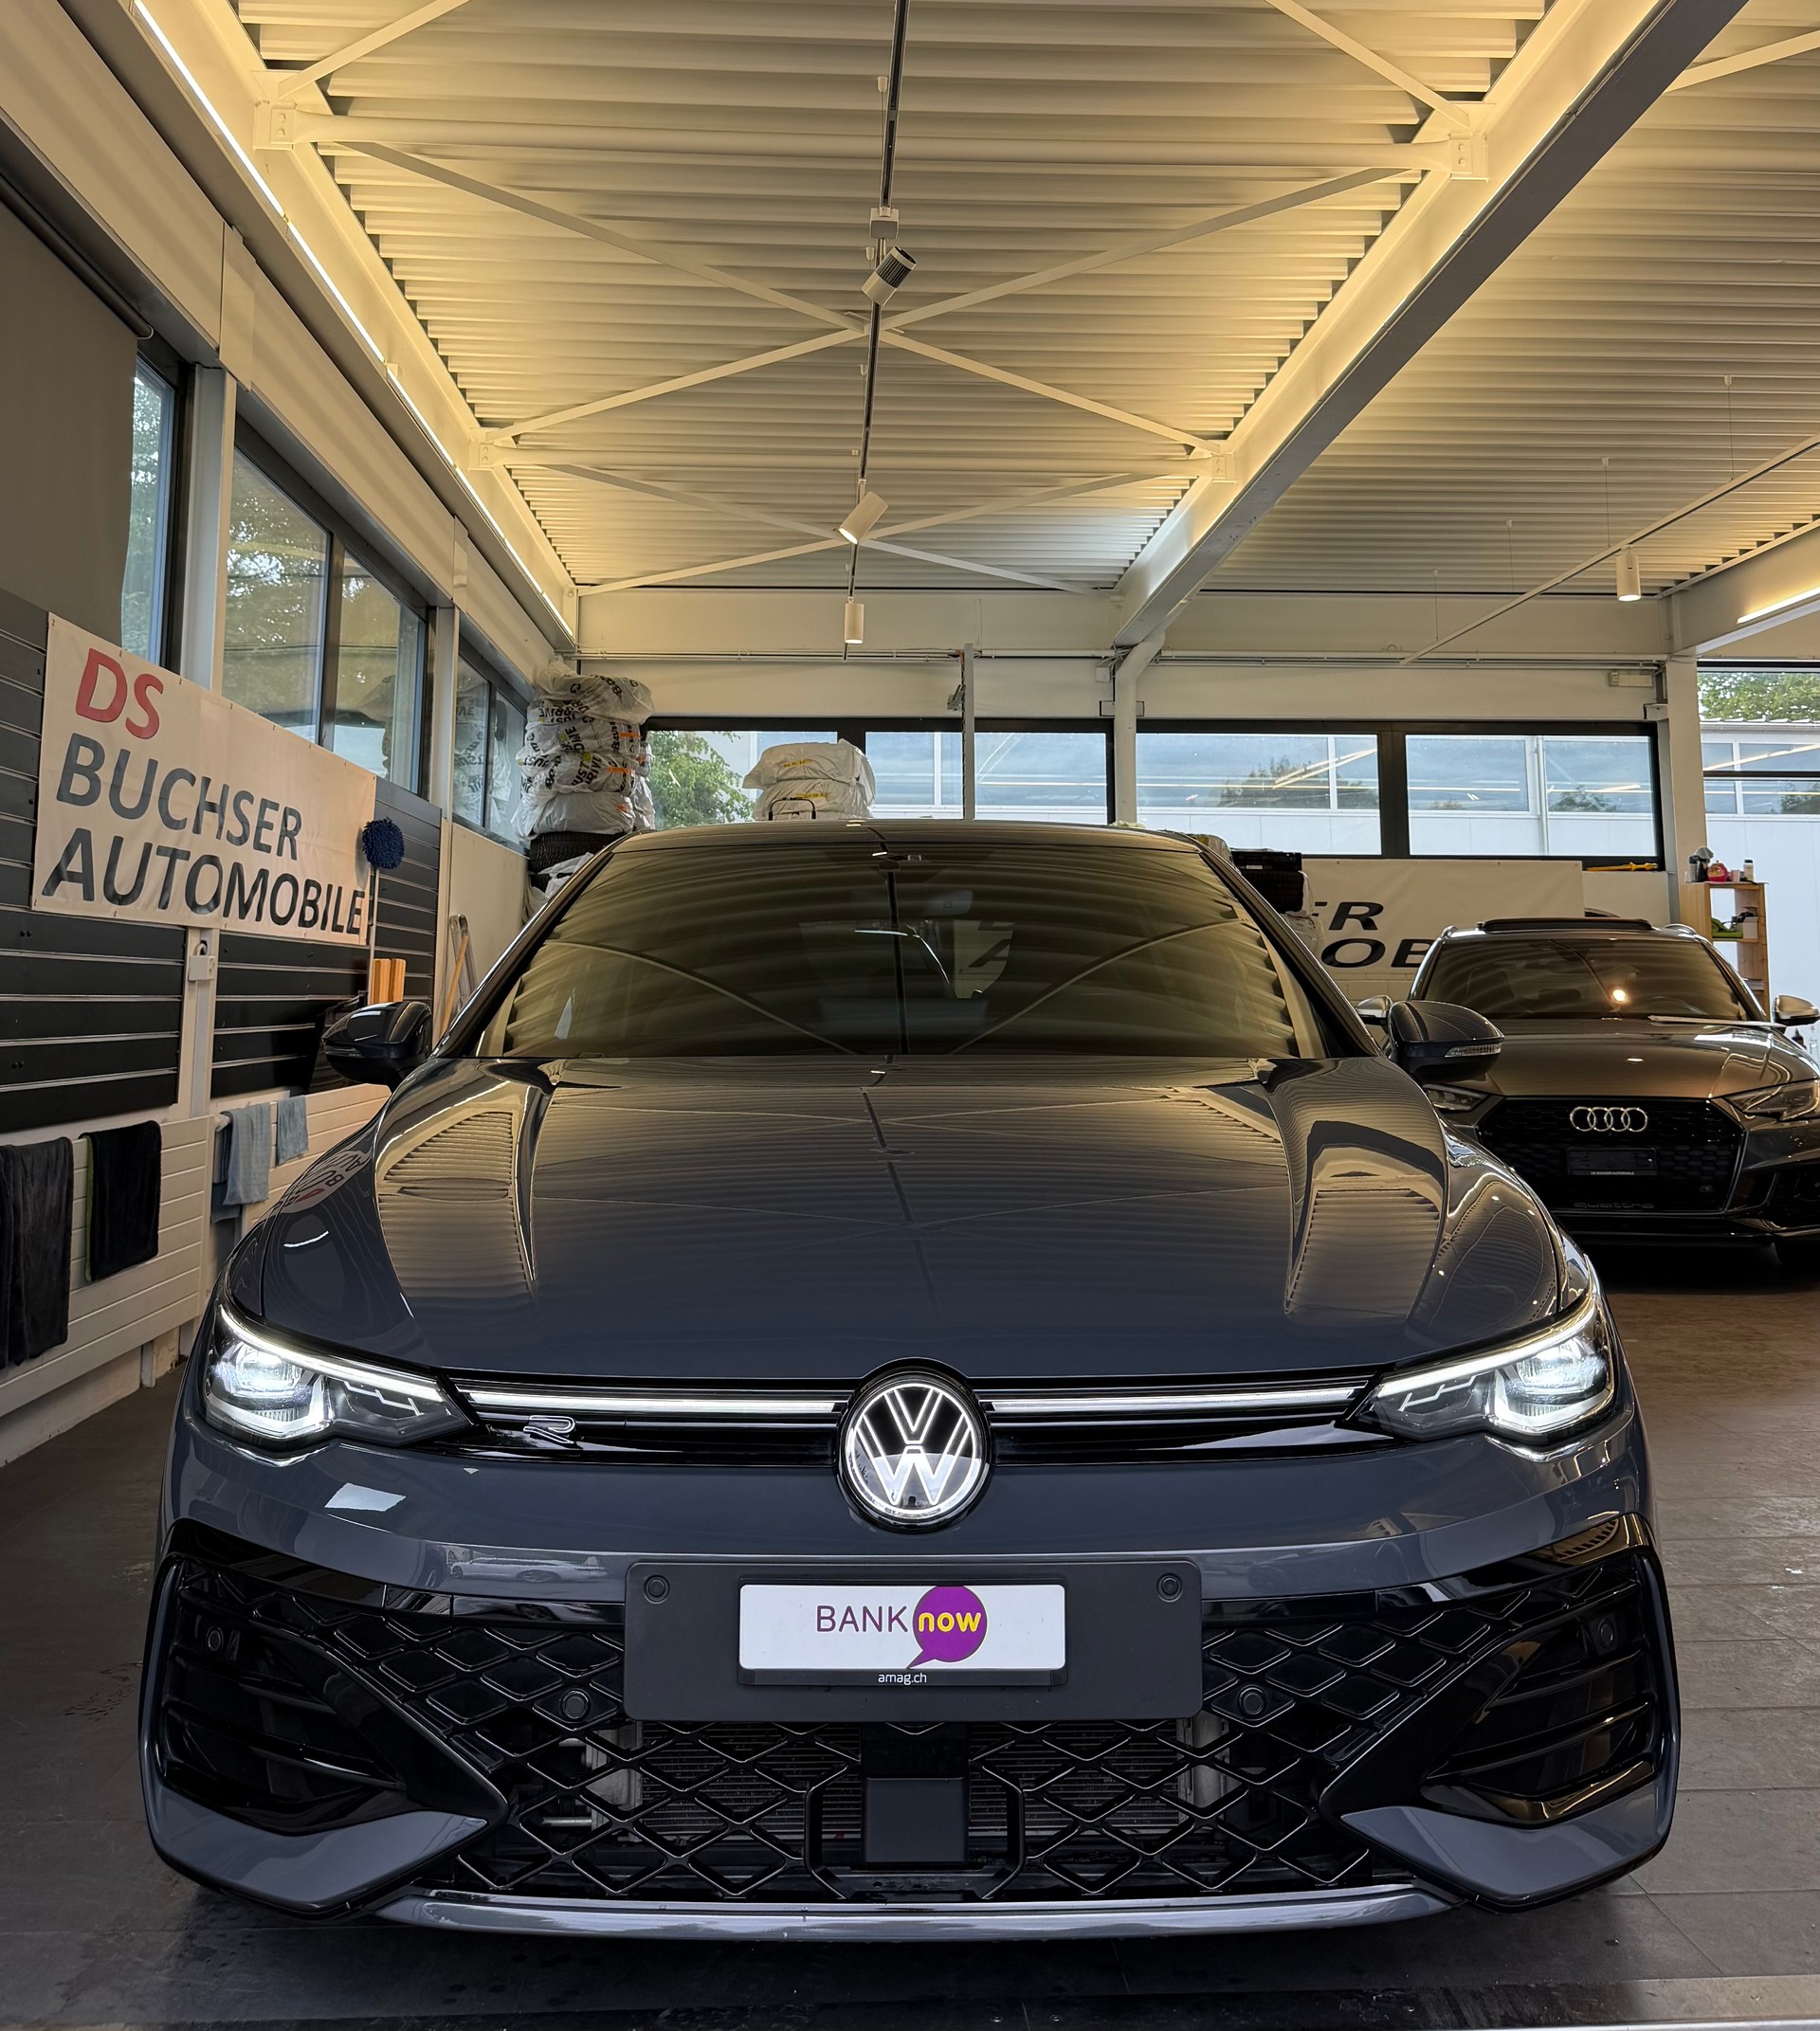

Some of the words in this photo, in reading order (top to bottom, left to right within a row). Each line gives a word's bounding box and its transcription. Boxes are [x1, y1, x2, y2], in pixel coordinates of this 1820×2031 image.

[75, 647, 164, 740] DS
[56, 732, 303, 861] BUCHSER
[42, 827, 366, 936] AUTOMOBILE
[816, 1605, 908, 1633] BANK
[917, 1610, 982, 1633] now
[878, 1672, 927, 1685] amag.ch
